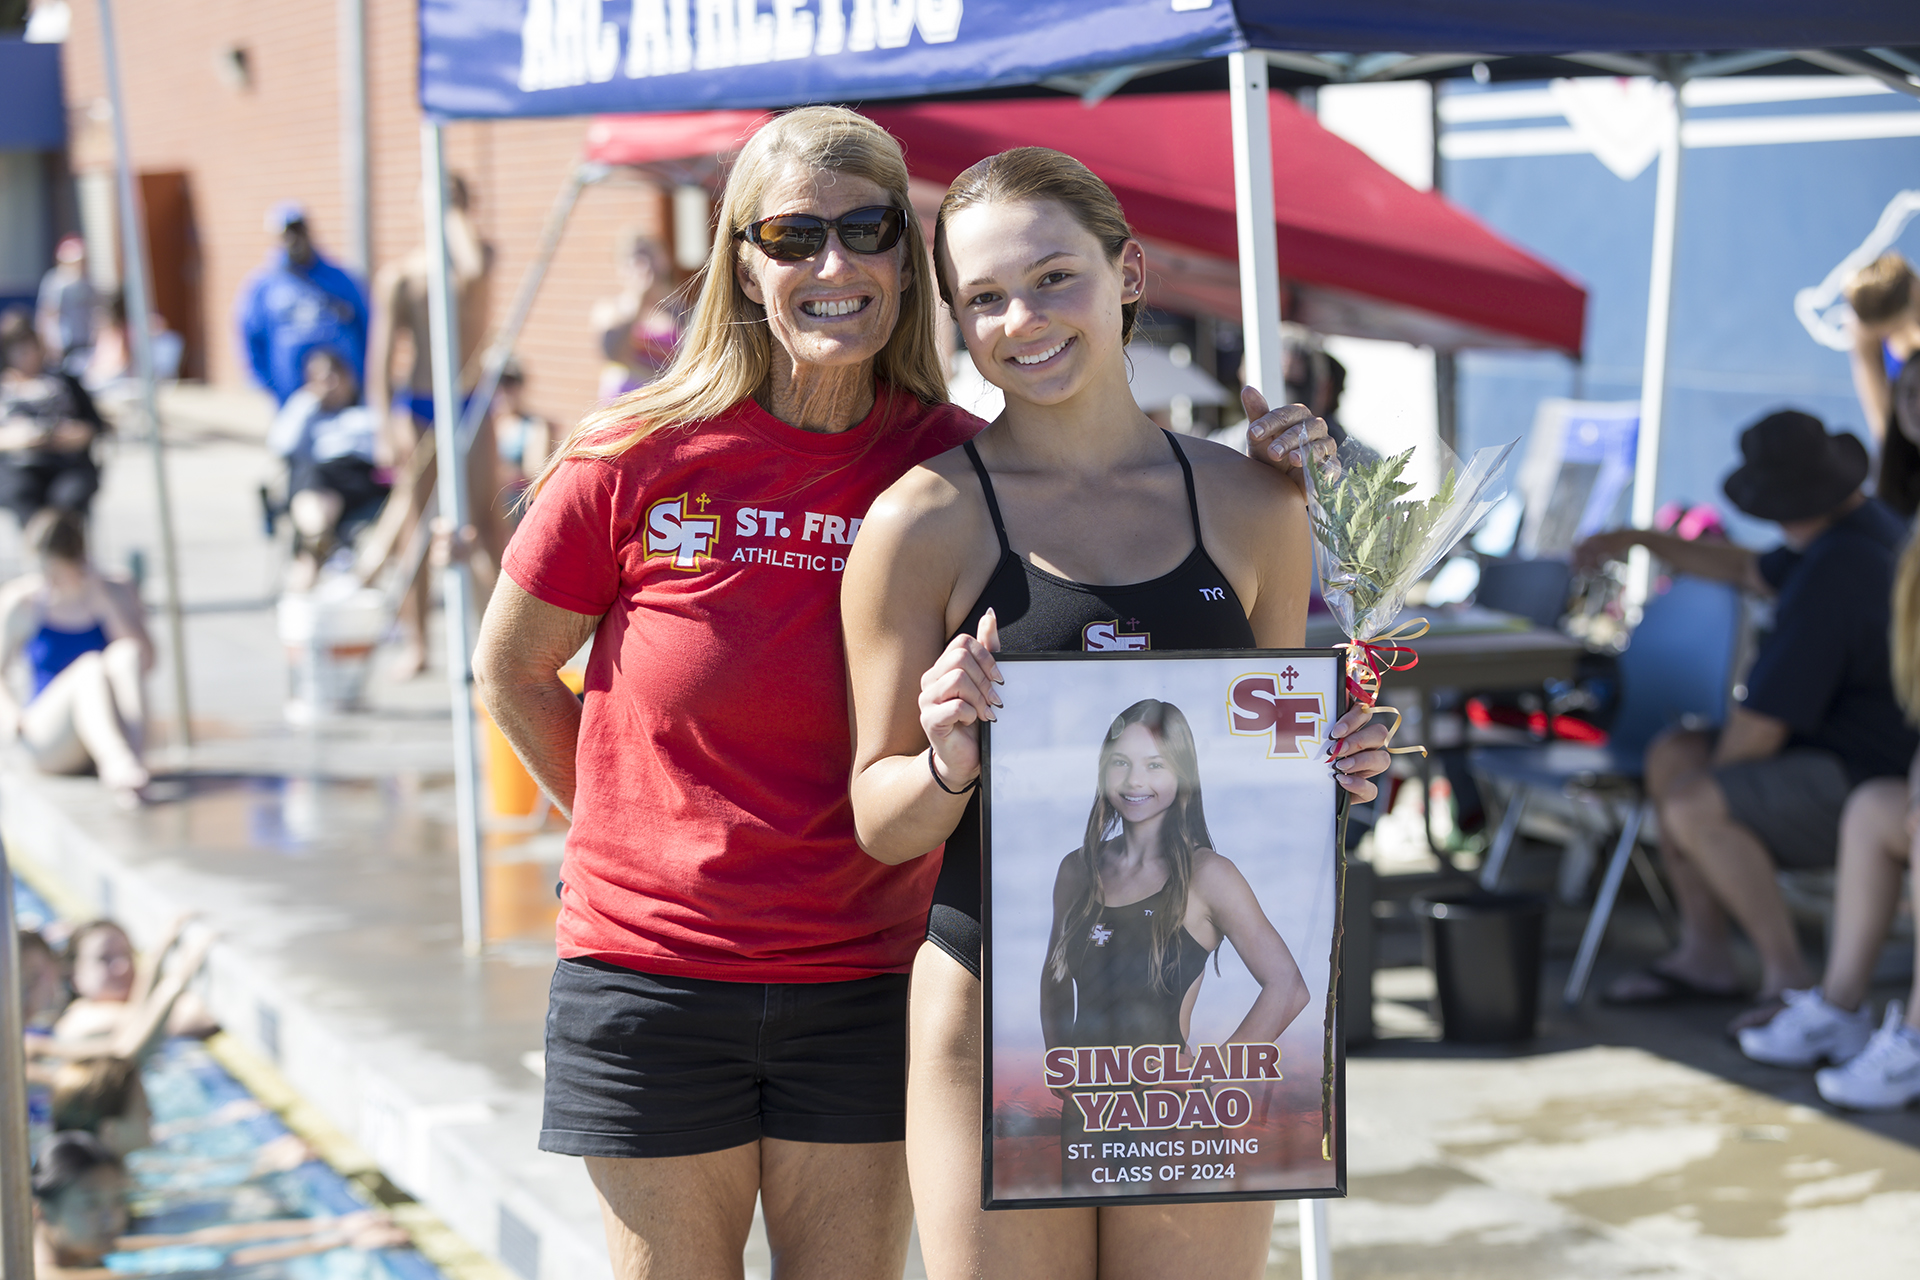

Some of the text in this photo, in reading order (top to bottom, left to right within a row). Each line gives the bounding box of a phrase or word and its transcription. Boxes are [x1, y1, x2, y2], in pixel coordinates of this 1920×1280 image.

[647, 499, 715, 568] SF
[735, 507, 791, 538] ST.
[731, 547, 826, 572] ATHLETIC
[1198, 586, 1226, 601] TYR
[1231, 676, 1322, 755] SF
[1044, 1042, 1283, 1088] SINCLAIR
[1072, 1087, 1252, 1132] YADAO
[1067, 1138, 1259, 1160] ST. FRANCIS DIVING
[1091, 1163, 1236, 1184] CLASS OF 2024
